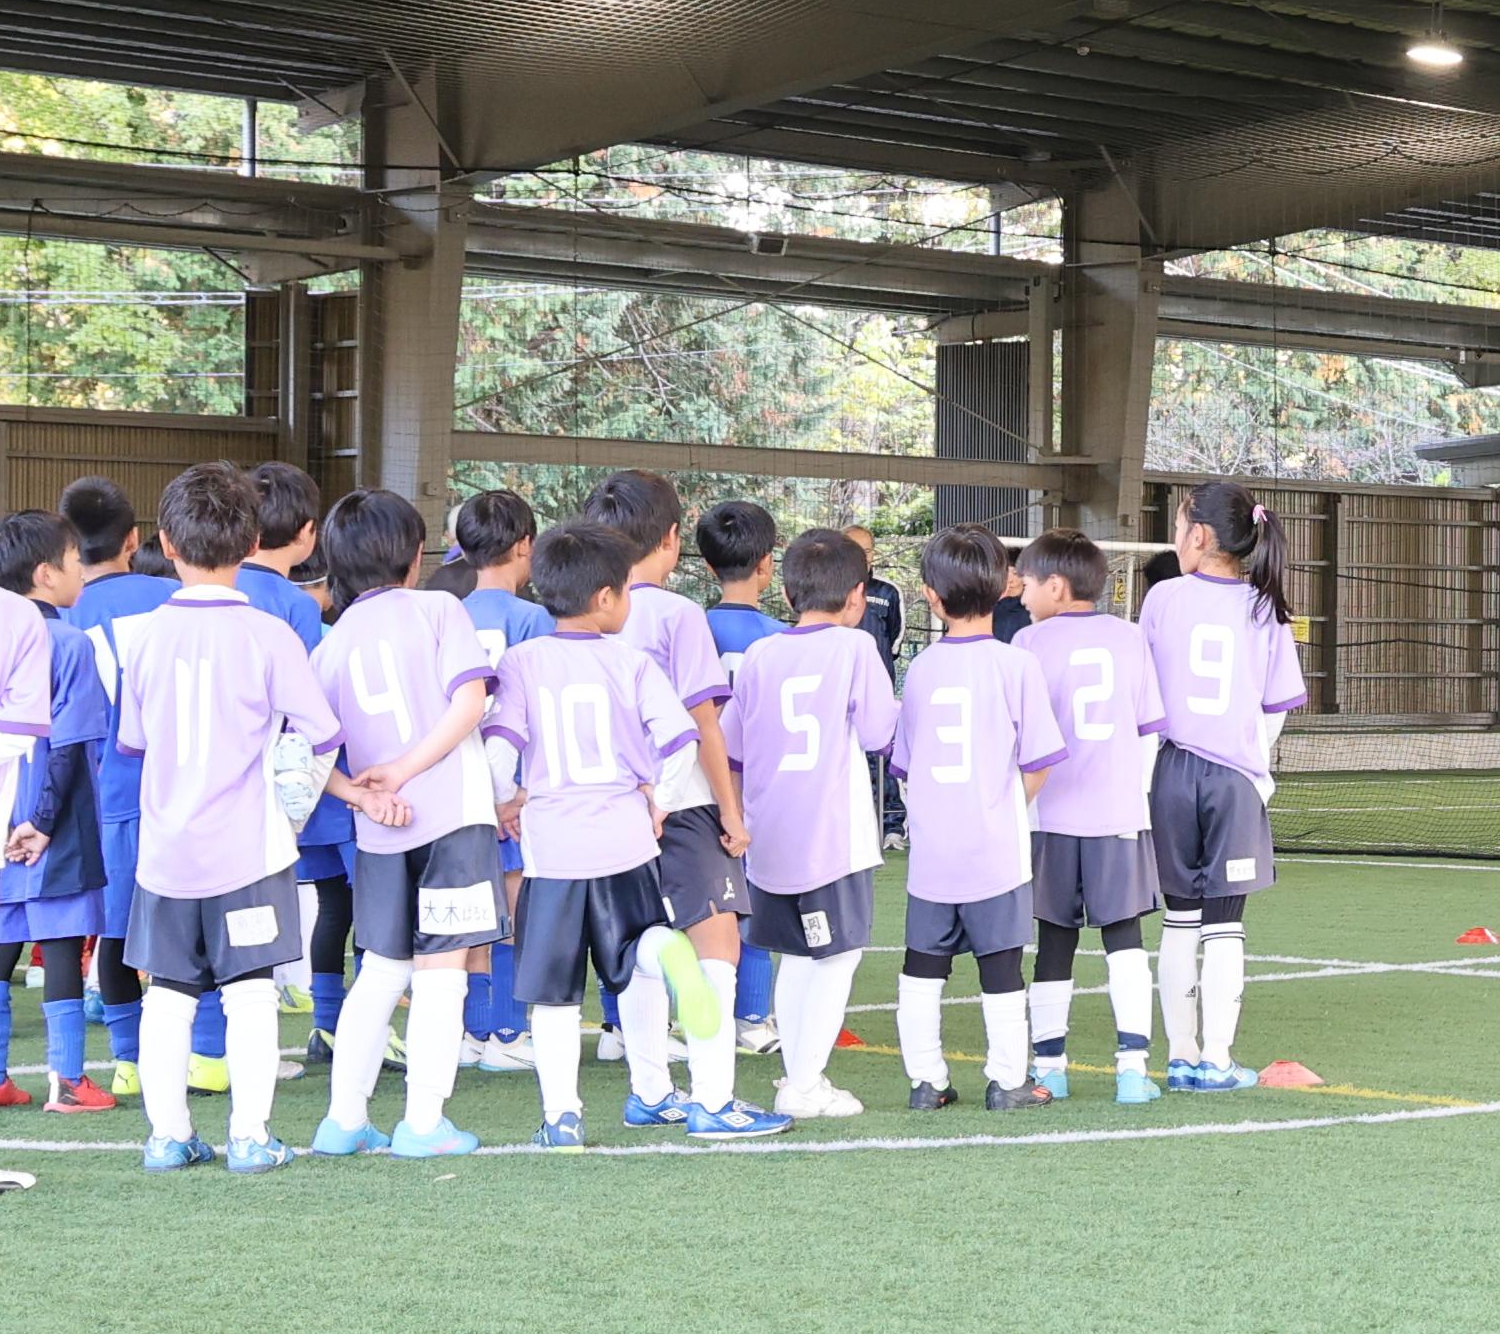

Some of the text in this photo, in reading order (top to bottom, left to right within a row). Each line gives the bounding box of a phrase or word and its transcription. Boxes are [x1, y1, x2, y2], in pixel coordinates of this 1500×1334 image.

[175, 658, 211, 767] 11
[348, 639, 413, 743] 4
[1068, 647, 1115, 741] 2
[1186, 623, 1235, 716] 9
[538, 683, 619, 788] 10
[777, 674, 822, 771] 5
[930, 686, 972, 783] 3
